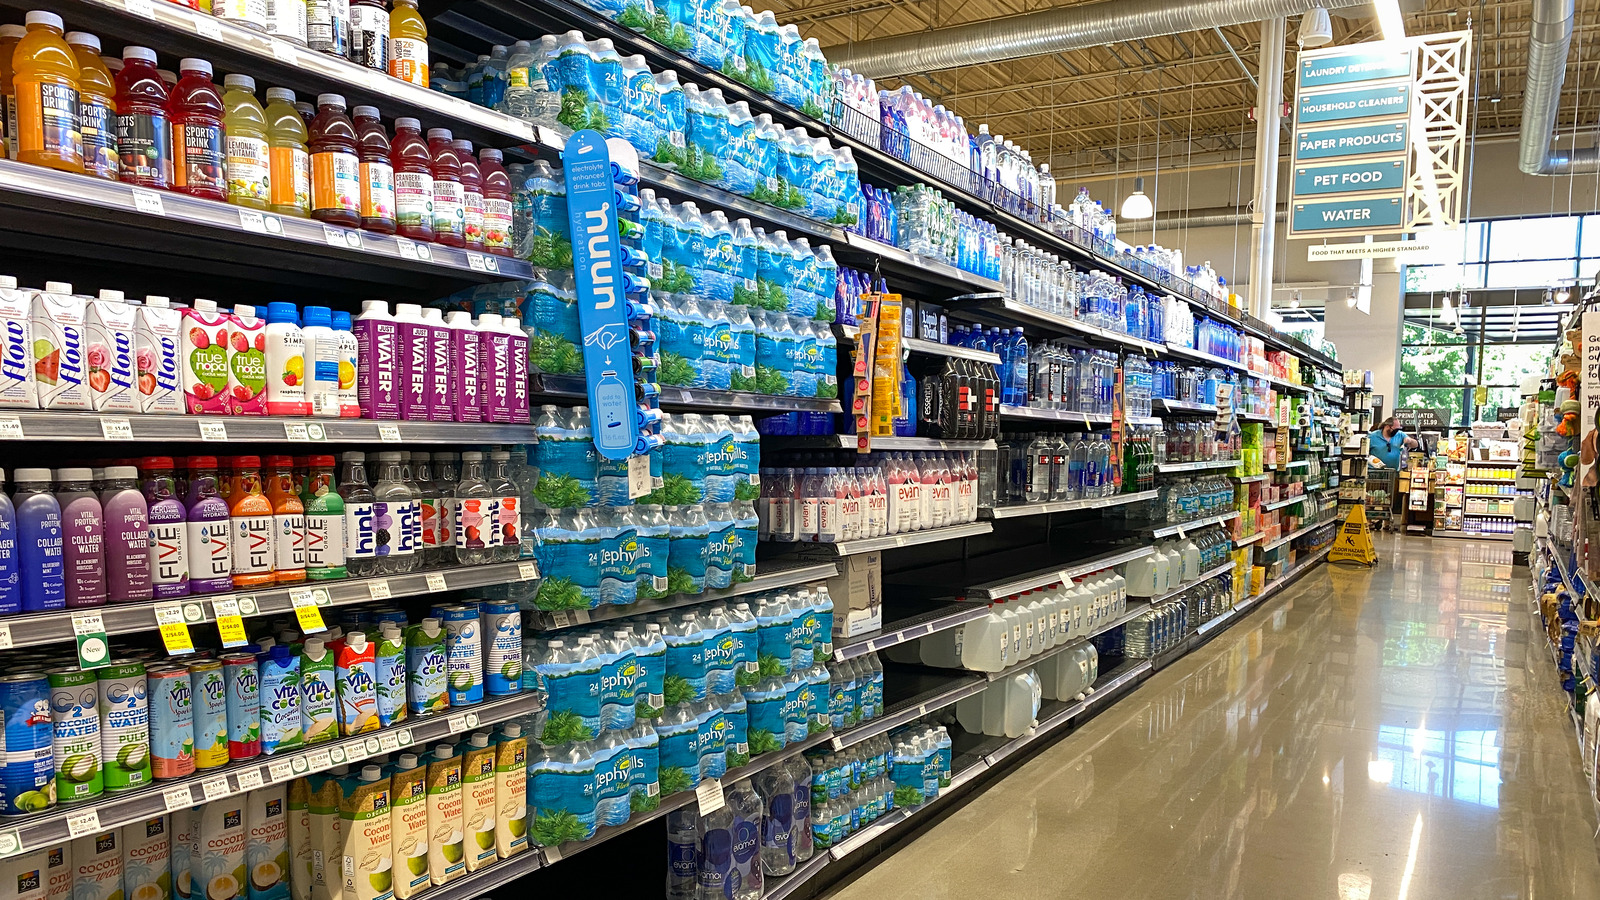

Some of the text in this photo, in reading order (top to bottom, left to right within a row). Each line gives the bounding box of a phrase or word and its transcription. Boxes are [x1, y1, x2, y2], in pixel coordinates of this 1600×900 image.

[1305, 66, 1347, 78] LAUNDRY
[42, 84, 74, 101] SPORTS
[43, 96, 68, 111] DRINK
[1302, 96, 1404, 114] HOUSEHOLD CLEANERS
[186, 126, 214, 139] SPORTS
[186, 136, 209, 148] DRINK
[1300, 133, 1403, 151] PAPER PRODUCTS
[572, 164, 604, 173] electrolyte
[573, 172, 605, 181] enhanced
[1314, 171, 1383, 186] PET FOOD
[1322, 208, 1371, 222] WATER
[575, 212, 587, 271] hydration
[585, 202, 616, 310] nuun
[435, 331, 449, 339] JUST
[2, 321, 26, 382] flow
[60, 326, 82, 385] flow
[196, 352, 223, 364] true
[111, 332, 132, 389] flow
[158, 337, 176, 392] flow
[236, 355, 260, 366] true
[377, 334, 392, 392] WATER
[411, 337, 425, 394] WATER
[434, 338, 447, 395] WATER
[464, 343, 477, 396] WATER
[494, 345, 507, 398] WATER
[514, 348, 525, 399] WATER
[924, 383, 932, 415] essentia
[586, 450, 595, 458] 24
[705, 448, 747, 464] Zephyills
[899, 485, 920, 501] evan
[74, 518, 99, 528] PROTEINS
[354, 506, 373, 554] hint
[397, 502, 413, 551] hint
[72, 535, 102, 545] COLLAGEN
[128, 540, 147, 549] WATER
[250, 520, 268, 568] FIVE
[292, 518, 304, 564] FIVE
[308, 519, 323, 564] FIVE
[78, 544, 99, 554] WATER
[158, 527, 179, 579] FIVE
[210, 525, 228, 574] FIVE
[600, 543, 650, 565] Zephyills
[588, 553, 598, 561] 24
[705, 638, 744, 661] Zephyills
[424, 654, 445, 666] VITA
[237, 675, 258, 687] VITA
[346, 672, 372, 687] VITA
[601, 666, 646, 691] Zephyills
[170, 688, 191, 700] VITA
[204, 680, 225, 693] VITA
[274, 686, 298, 700] VITA
[301, 681, 330, 696] VITA
[590, 683, 599, 691] 24
[272, 696, 300, 710] COCO
[309, 690, 335, 702] COCO
[53, 715, 98, 728] COCONUT
[54, 724, 98, 738] WATER
[119, 731, 146, 743] PULP
[64, 742, 93, 754] PULP
[595, 756, 644, 789] Zephyills
[584, 784, 593, 793] 24
[226, 815, 239, 825] 365
[733, 837, 757, 851] evamor
[673, 861, 696, 870] evam
